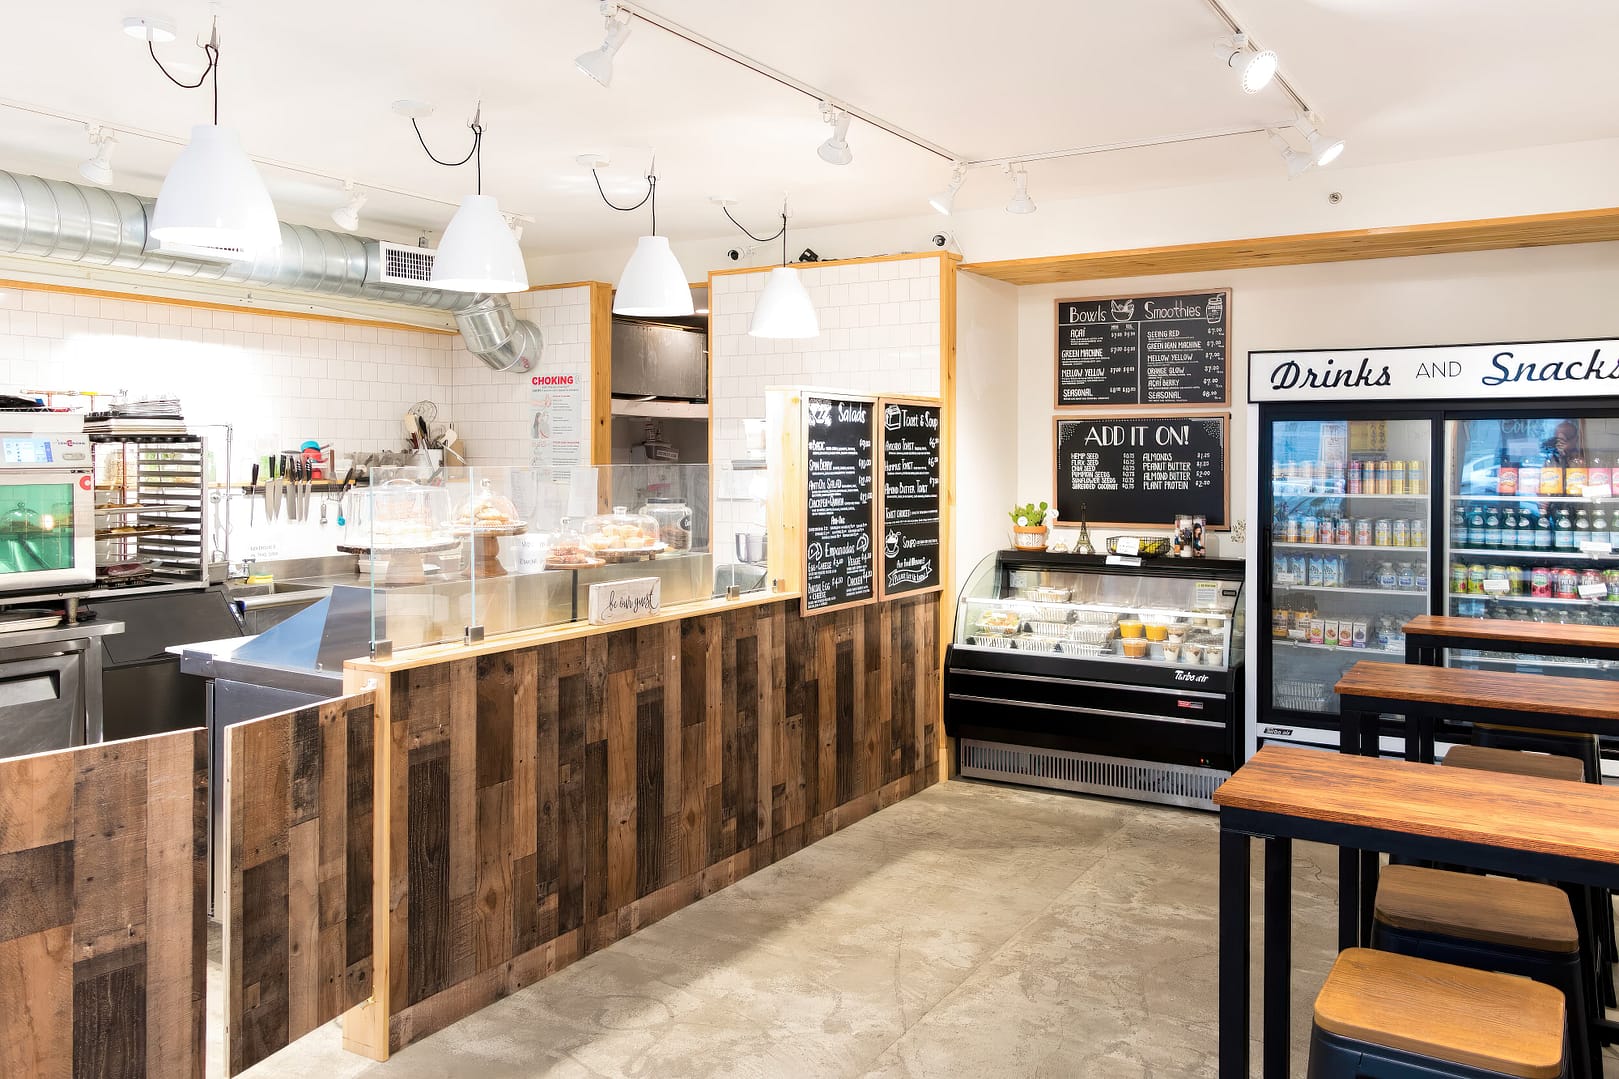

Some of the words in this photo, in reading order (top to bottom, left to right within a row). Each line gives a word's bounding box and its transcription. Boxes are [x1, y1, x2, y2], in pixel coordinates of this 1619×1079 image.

[1070, 304, 1107, 323] Bowls
[1144, 300, 1200, 320] Smoothies
[1146, 342, 1164, 350] GREEN
[1178, 340, 1202, 349] MACHINE
[1062, 349, 1080, 358] GREEN
[1080, 348, 1104, 357] MACHINE
[1147, 354, 1170, 362] MELLOW
[1170, 352, 1194, 361] YELLOW
[1062, 368, 1083, 378] MELLOW
[1084, 368, 1105, 376] YELLOW
[1146, 366, 1167, 375] ORANGE
[1270, 358, 1391, 390] Drinks
[1416, 360, 1462, 380] AND
[532, 376, 574, 386] CHOKING
[1063, 388, 1094, 398] SEASONAL
[1148, 390, 1182, 400] SEASONAL
[838, 402, 866, 424] Salads
[920, 414, 924, 427] &
[925, 410, 939, 430] Soup
[1084, 426, 1125, 446] ADD
[1130, 426, 1149, 446] IT
[1155, 425, 1190, 446] ON!
[1142, 452, 1173, 462] ALMONDS
[1142, 462, 1167, 471] PEANUT
[1168, 461, 1192, 471] BUTTER
[1144, 472, 1168, 481] ALMOND
[1169, 471, 1192, 481] BUTTER
[1144, 481, 1162, 490] PLANT
[1164, 480, 1189, 490] PROTEIN
[825, 541, 855, 560] Empanadas
[633, 584, 659, 613] guest
[1196, 674, 1209, 683] air
